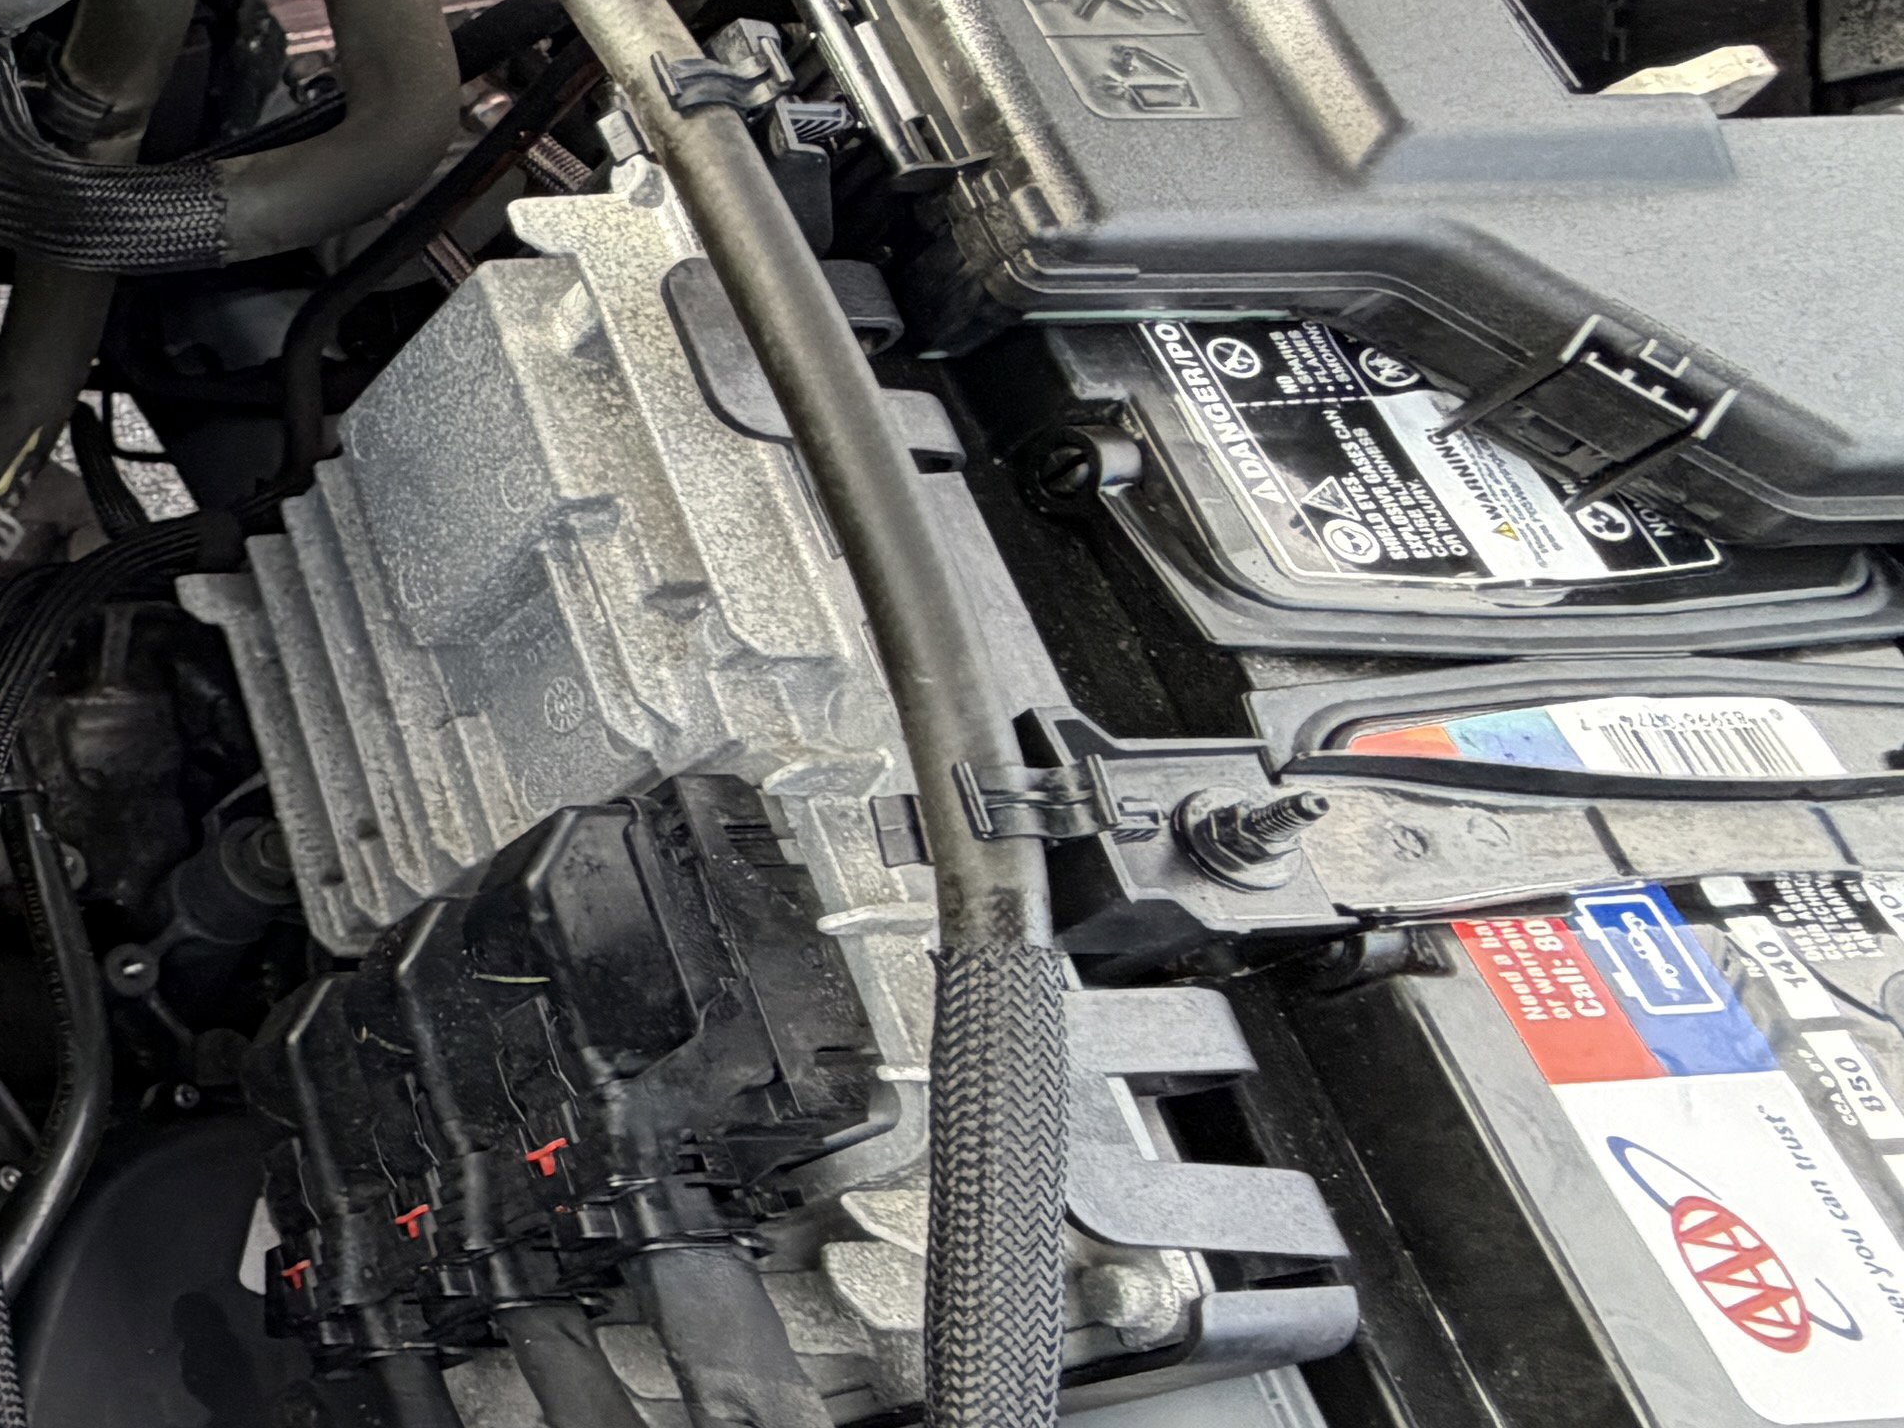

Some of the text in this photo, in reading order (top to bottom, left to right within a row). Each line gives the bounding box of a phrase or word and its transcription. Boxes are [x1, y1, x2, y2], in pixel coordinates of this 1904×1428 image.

[1269, 331, 1314, 385] SPARKS
[1287, 330, 1333, 383] FLAMES
[1276, 375, 1301, 394] NO
[1323, 409, 1433, 559] EXPLOSIVE GASES CAN
[1353, 428, 1449, 558] CAUSE BLINDNESS
[1365, 513, 1410, 560] SHIELD
[1442, 535, 1468, 556] OR
[1492, 954, 1513, 965] a
[1756, 940, 1808, 988] 140
[1499, 971, 1548, 1020] Need
[1546, 998, 1573, 1019] or
[1551, 958, 1606, 1017] Call:
[1834, 1057, 1886, 1112] 850
[1811, 1180, 1850, 1220] can
[1677, 1208, 1801, 1332] AAA
[1842, 1229, 1894, 1278] you
